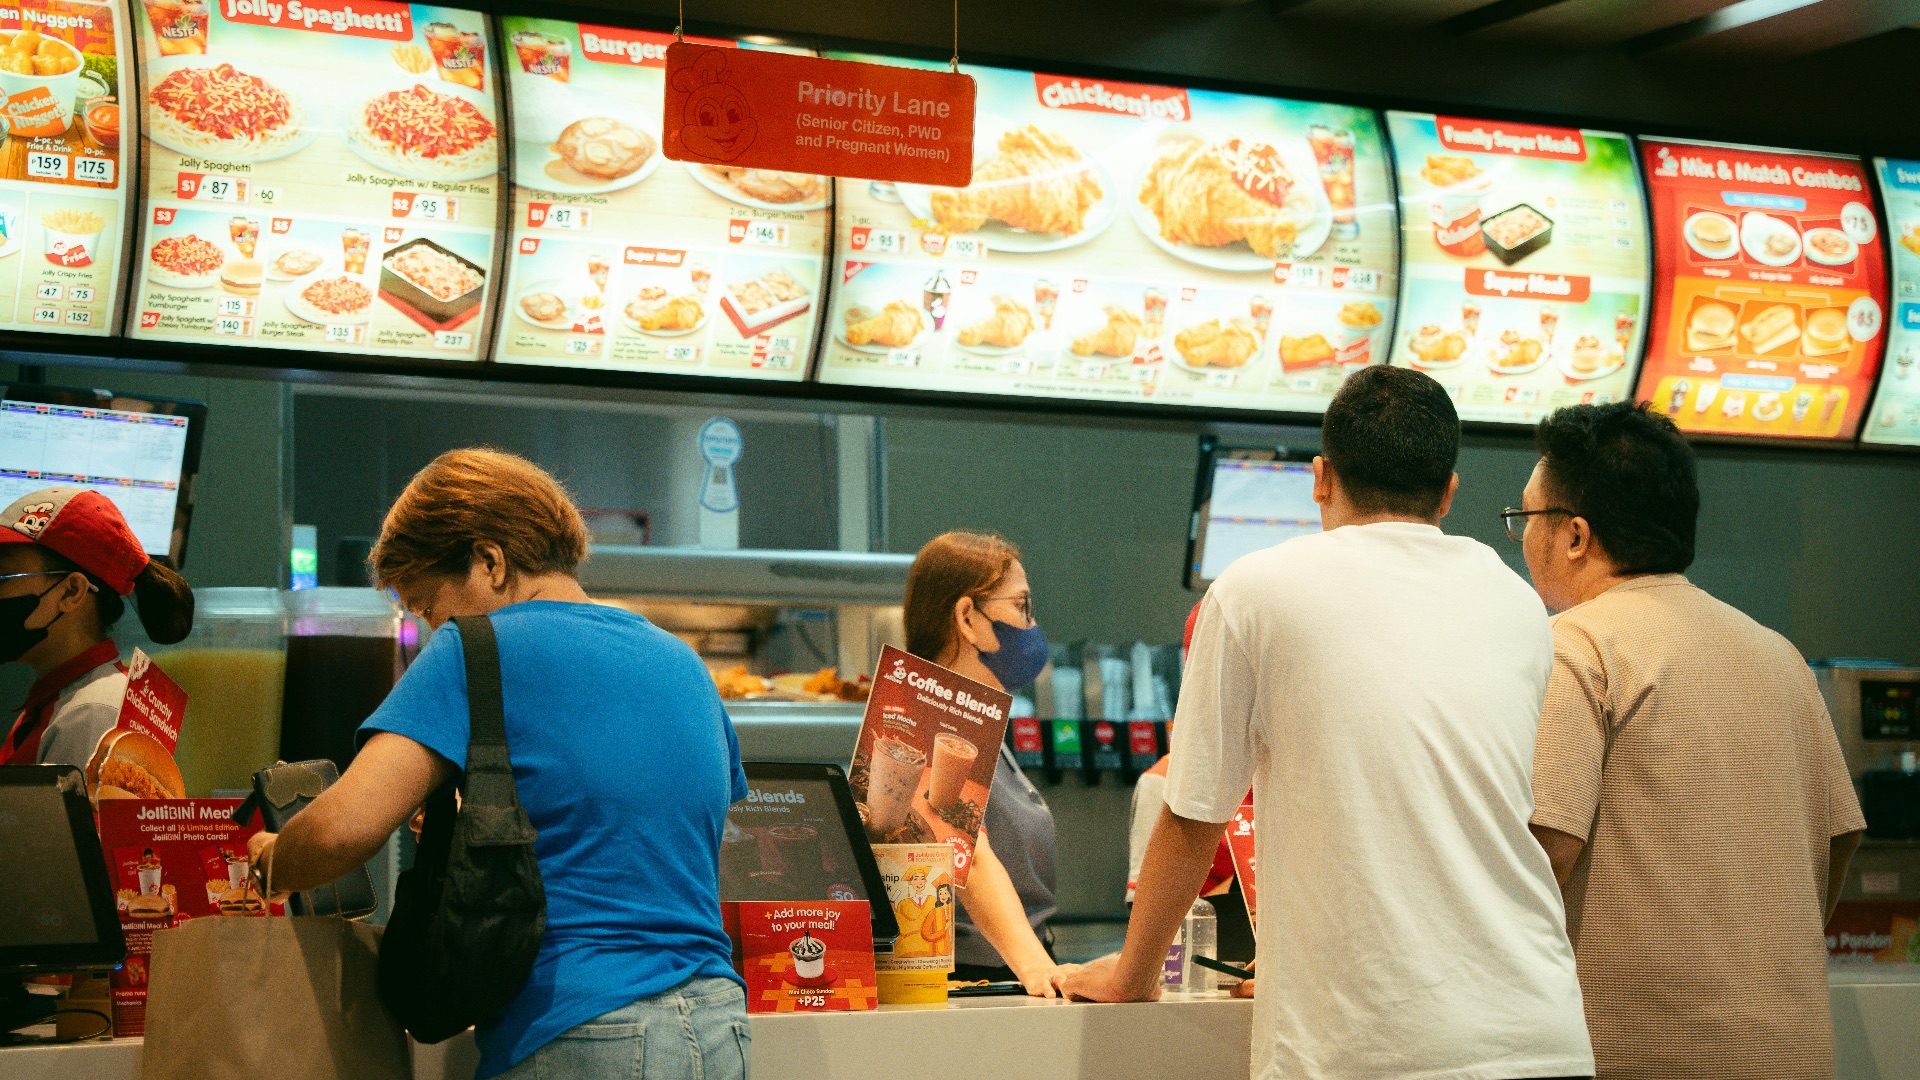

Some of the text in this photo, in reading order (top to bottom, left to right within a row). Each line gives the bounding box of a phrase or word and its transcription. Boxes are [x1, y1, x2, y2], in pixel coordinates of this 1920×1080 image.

[23, 10, 93, 31] Nuggets
[227, 0, 403, 35] Jolly Spaghetti
[162, 22, 199, 38] NESTEA
[582, 33, 668, 63] Burger
[8, 95, 62, 117] Chicken
[799, 80, 951, 119] Priority Lane
[1042, 81, 1186, 121] Chickenjoy
[14, 107, 69, 131] Nuggets
[797, 112, 942, 141] (Senior Citizen, PWD
[27, 142, 72, 154] Fries & Drink
[796, 132, 951, 160] and Pregnant Women)
[179, 158, 251, 175] Jolly Spaghetti
[1681, 157, 1862, 191] Mix & Match Combos
[181, 180, 229, 194] S1 87
[346, 173, 490, 195] Jolly Spaghetti w/ Regular Fries
[260, 190, 274, 201] 60
[551, 193, 582, 204] Burger
[422, 200, 438, 213] 95
[556, 210, 572, 223] 87
[41, 268, 93, 279] Jolly Crispy Fries
[44, 287, 57, 298] 47
[76, 290, 89, 300] 75
[148, 292, 166, 303] Jolly
[168, 293, 202, 305] Spaghetti
[148, 301, 189, 312] Yumburger
[226, 300, 241, 311] 115
[41, 310, 55, 321] 94
[72, 312, 89, 323] 152
[222, 319, 239, 331] 140
[907, 671, 1003, 721] Coffee Blends
[148, 690, 173, 722] Crunchy
[916, 692, 984, 726] Deliciously Rich Blends
[126, 687, 178, 743] Chicken Sandwich
[882, 712, 917, 728] Iced Mocha
[747, 789, 806, 804] Blends
[745, 804, 763, 813] Rich
[764, 804, 792, 814] Blends
[140, 823, 240, 833] Collect all 16 Limited Edition
[183, 833, 205, 842] Photo
[206, 833, 230, 842] Cards!
[796, 908, 824, 917] more
[824, 907, 841, 921] joy
[163, 922, 169, 930] A
[772, 920, 836, 933] to your meal!
[798, 995, 826, 1008] +P25
